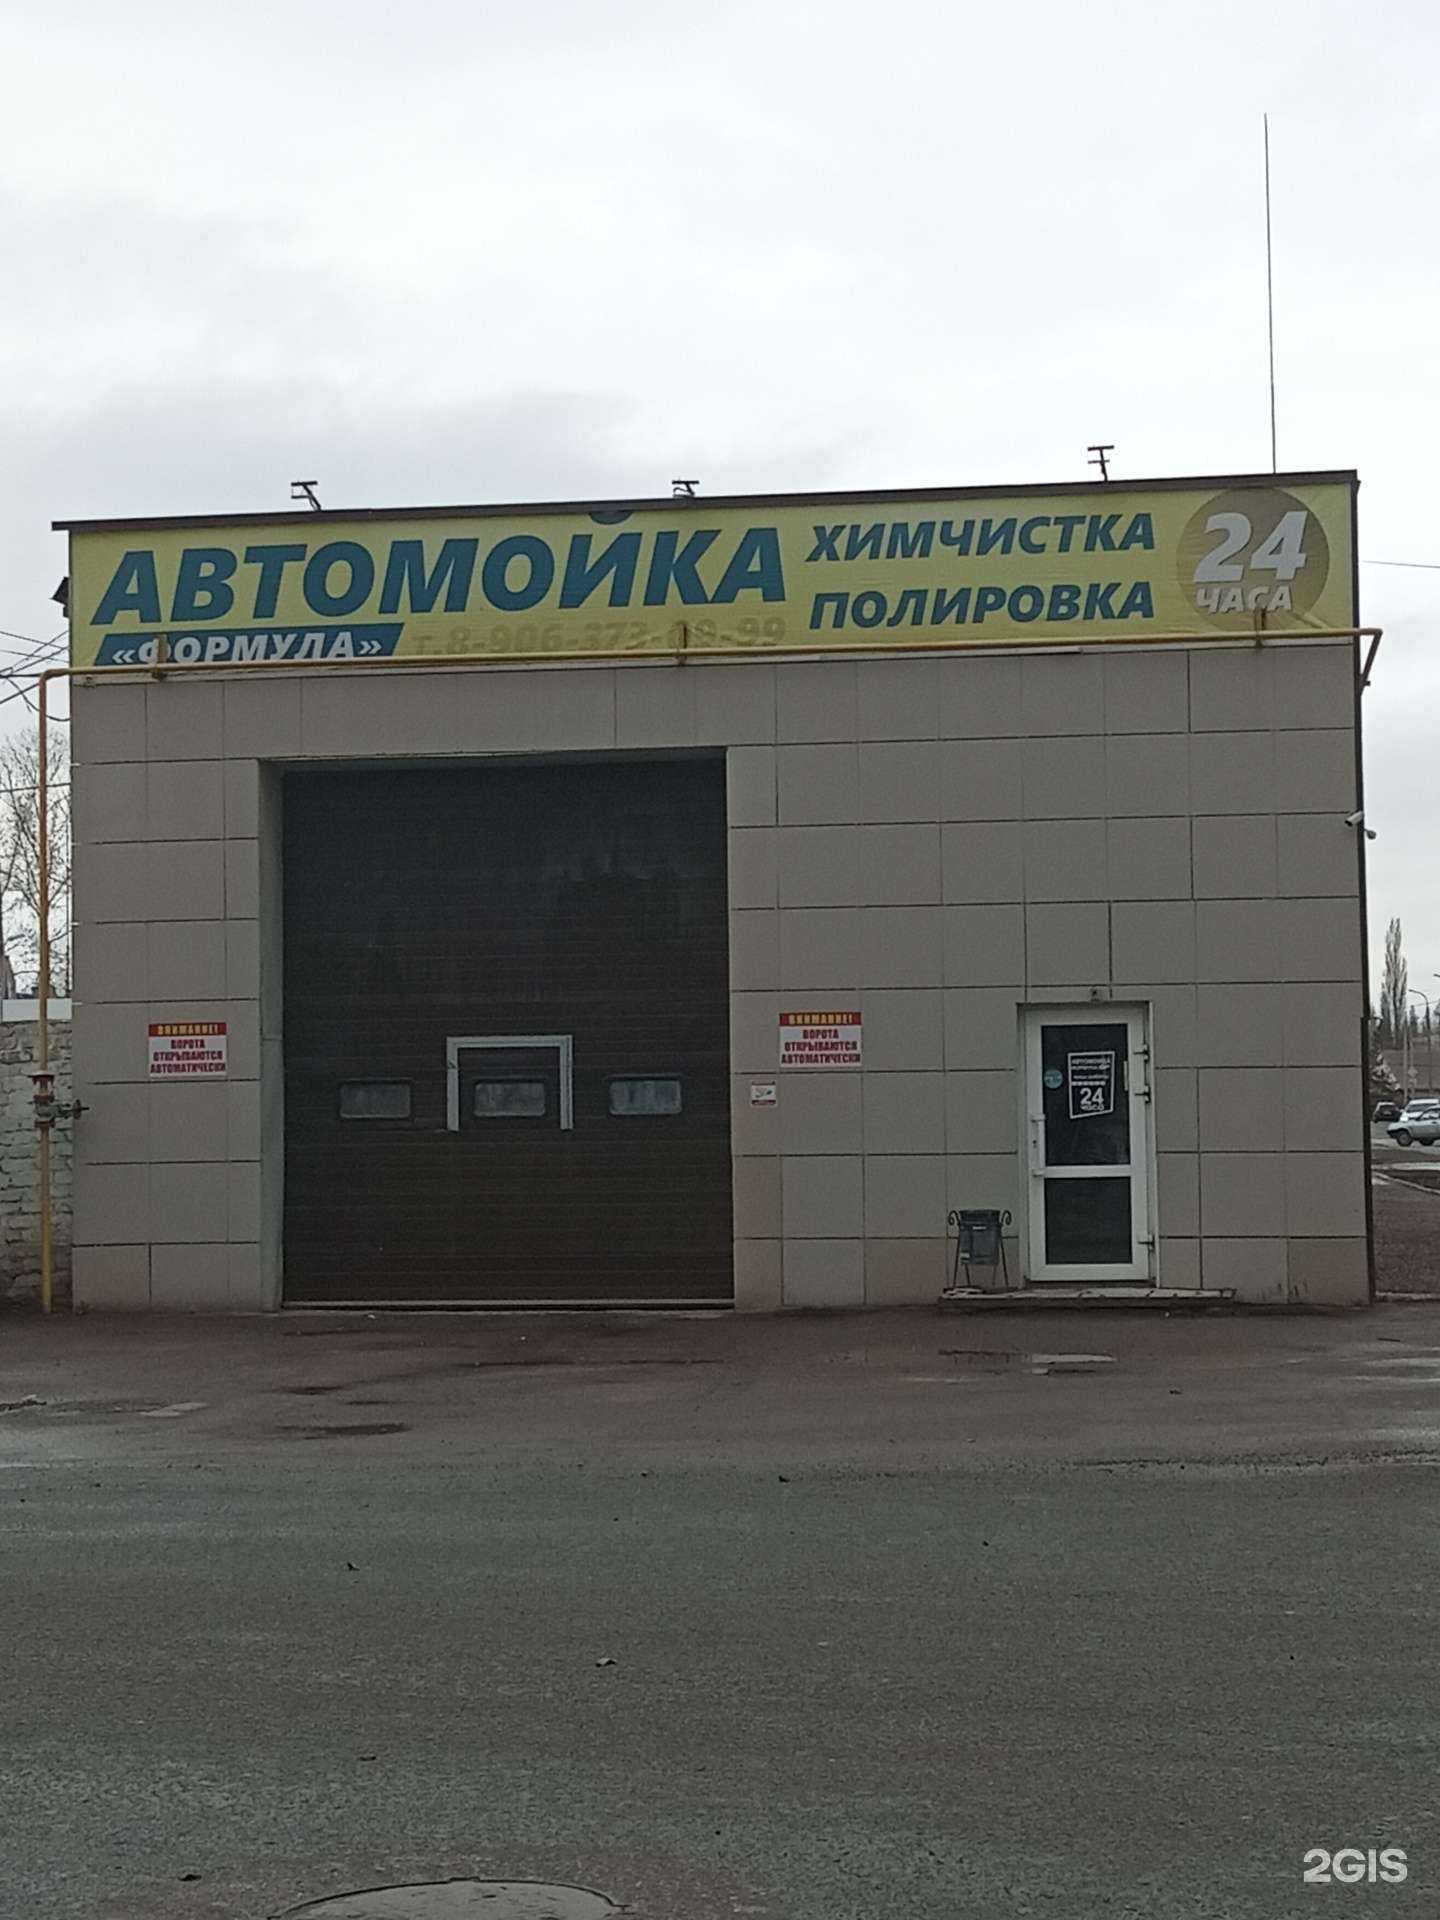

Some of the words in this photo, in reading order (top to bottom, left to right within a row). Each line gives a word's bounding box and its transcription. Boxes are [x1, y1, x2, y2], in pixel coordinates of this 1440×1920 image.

[804, 512, 1156, 562] ХИМЧИСТКА
[1193, 510, 1308, 583] 24
[91, 511, 786, 626] АВТОМОЙКА
[809, 581, 1155, 630] ПОЛИРОВКА
[1196, 585, 1292, 614] ЧАСА
[171, 1039, 206, 1049] ВОРОТА
[802, 1029, 839, 1039] ВОРОТА
[784, 1041, 858, 1052] ОТКРЫВАЮТСЯ
[781, 1053, 861, 1064] АВТОМАТИЧЕСКИ
[1080, 1087, 1104, 1105] 24
